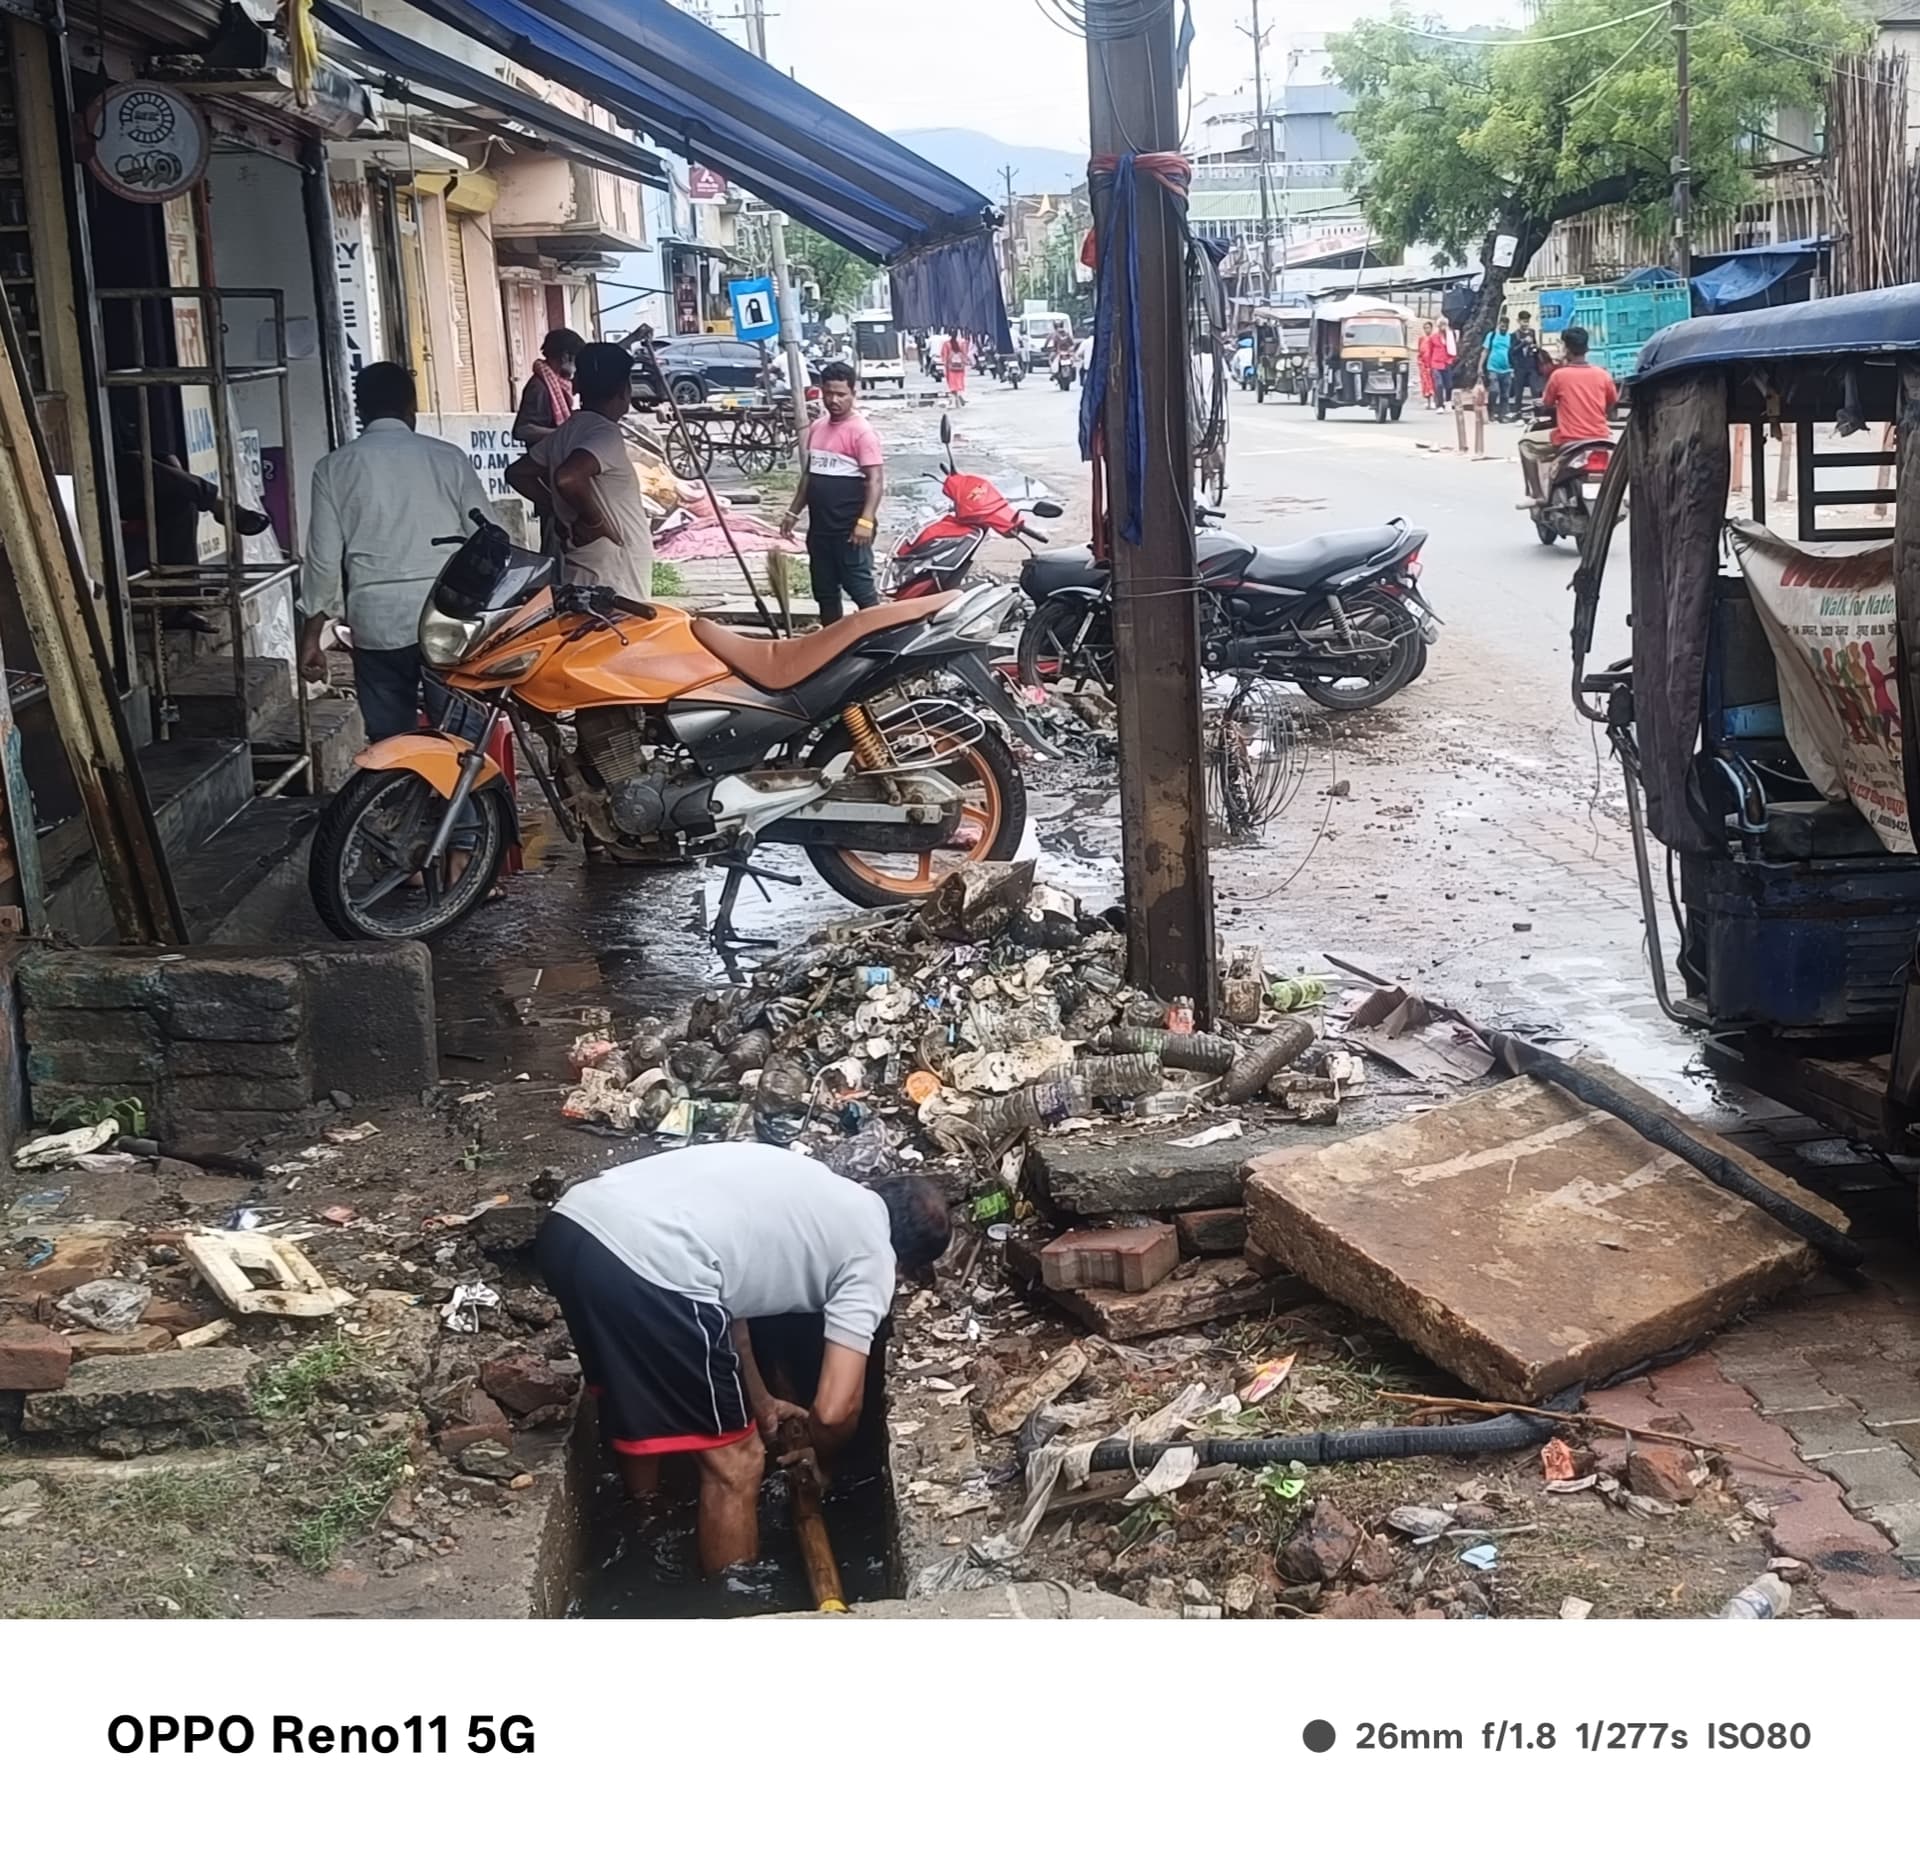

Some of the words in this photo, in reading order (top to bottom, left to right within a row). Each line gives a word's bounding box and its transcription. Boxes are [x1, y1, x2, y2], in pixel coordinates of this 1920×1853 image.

[471, 430, 496, 449] DRY
[1820, 595, 1847, 616] Walk
[1848, 594, 1865, 616] for
[1865, 593, 1895, 616] Natio
